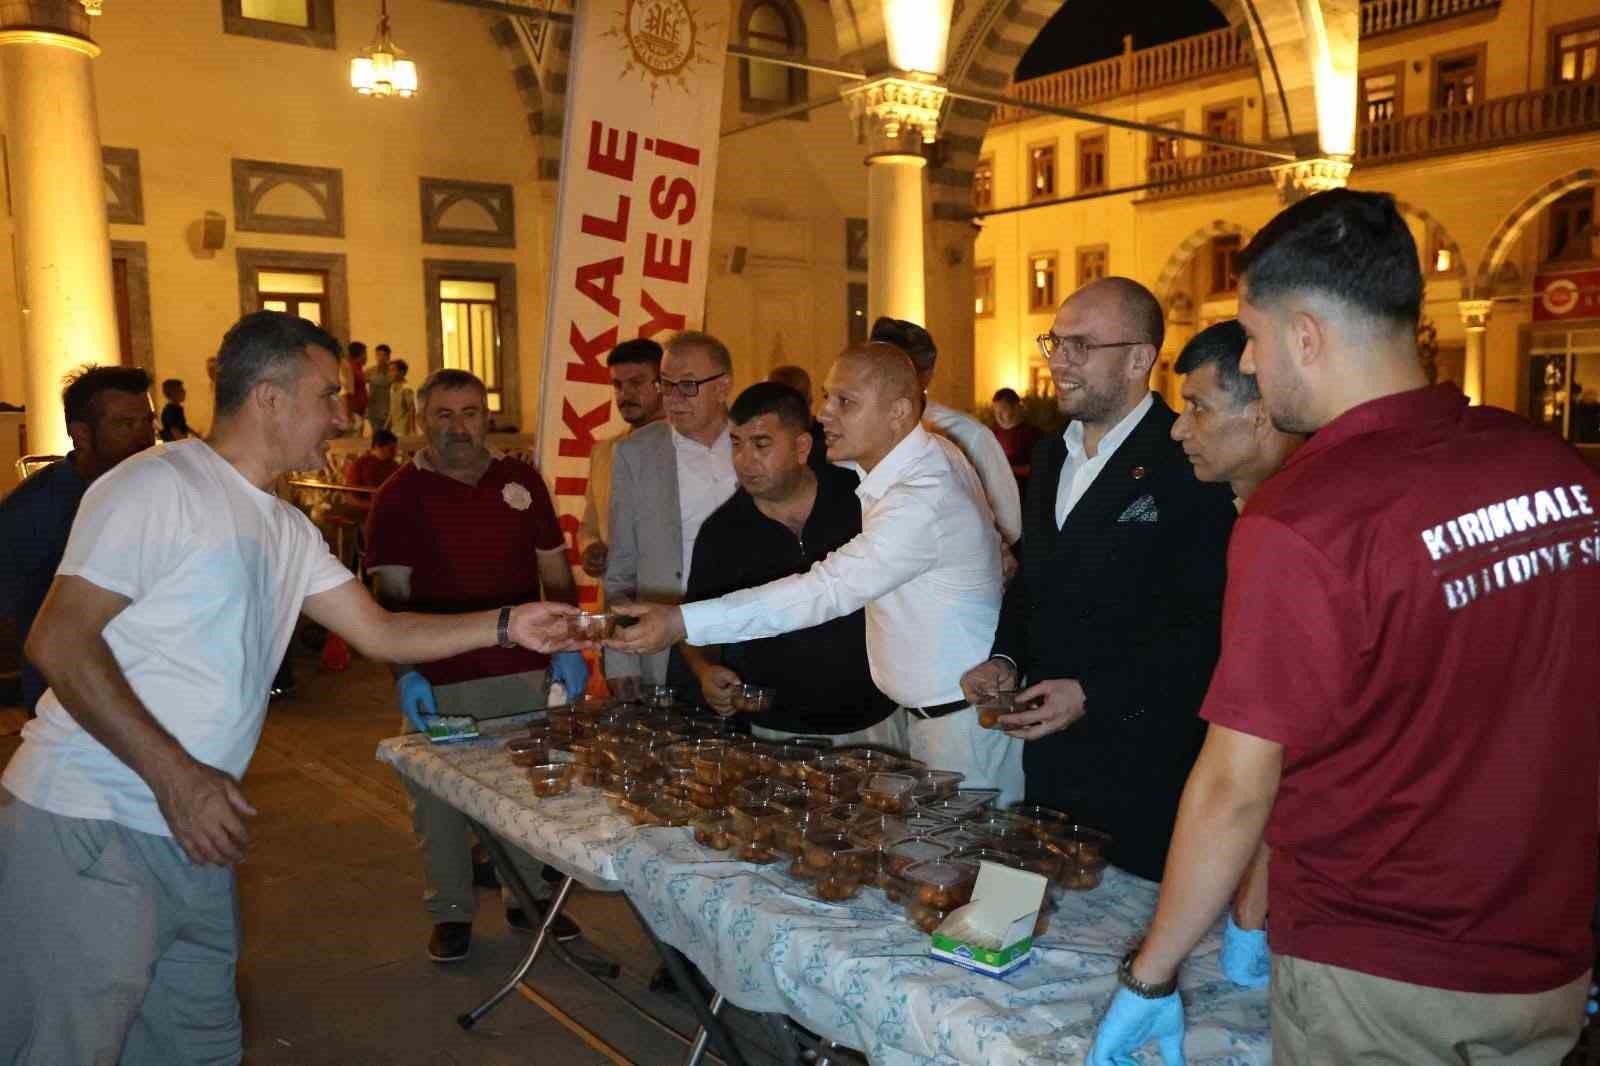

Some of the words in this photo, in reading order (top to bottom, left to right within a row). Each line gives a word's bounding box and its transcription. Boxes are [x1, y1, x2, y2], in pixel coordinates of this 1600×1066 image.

[638, 137, 700, 338] YESİ
[555, 120, 638, 604] IKKALE
[1421, 485, 1593, 560] KIRIKKALE
